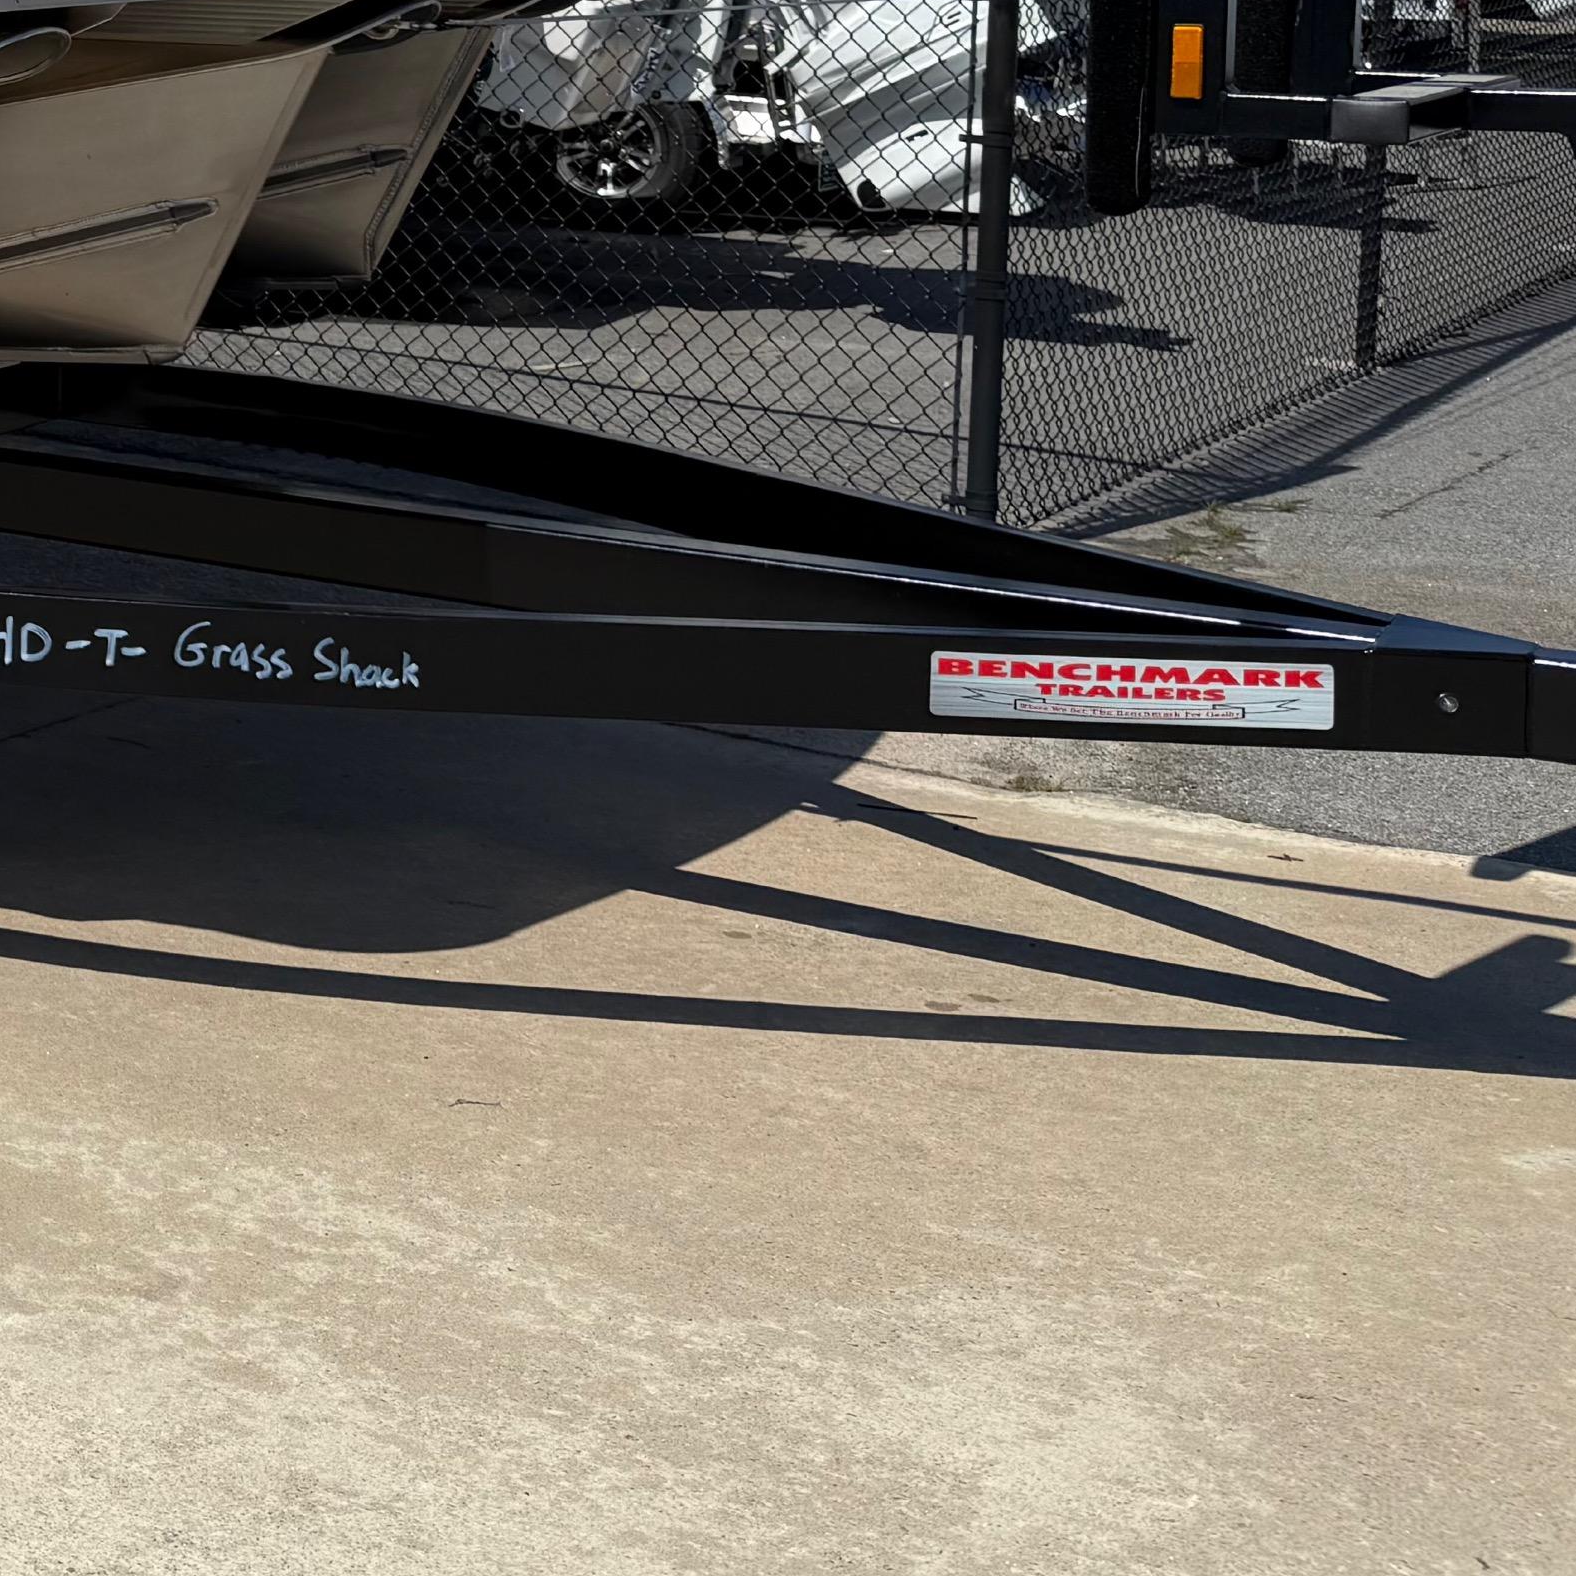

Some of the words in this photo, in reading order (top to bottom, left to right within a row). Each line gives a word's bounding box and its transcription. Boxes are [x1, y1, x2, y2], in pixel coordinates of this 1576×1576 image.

[173, 621, 294, 680] Grass
[313, 636, 420, 689] Shack
[937, 657, 1325, 689] BENCHMARK
[1034, 683, 1226, 702] TRAILERS
